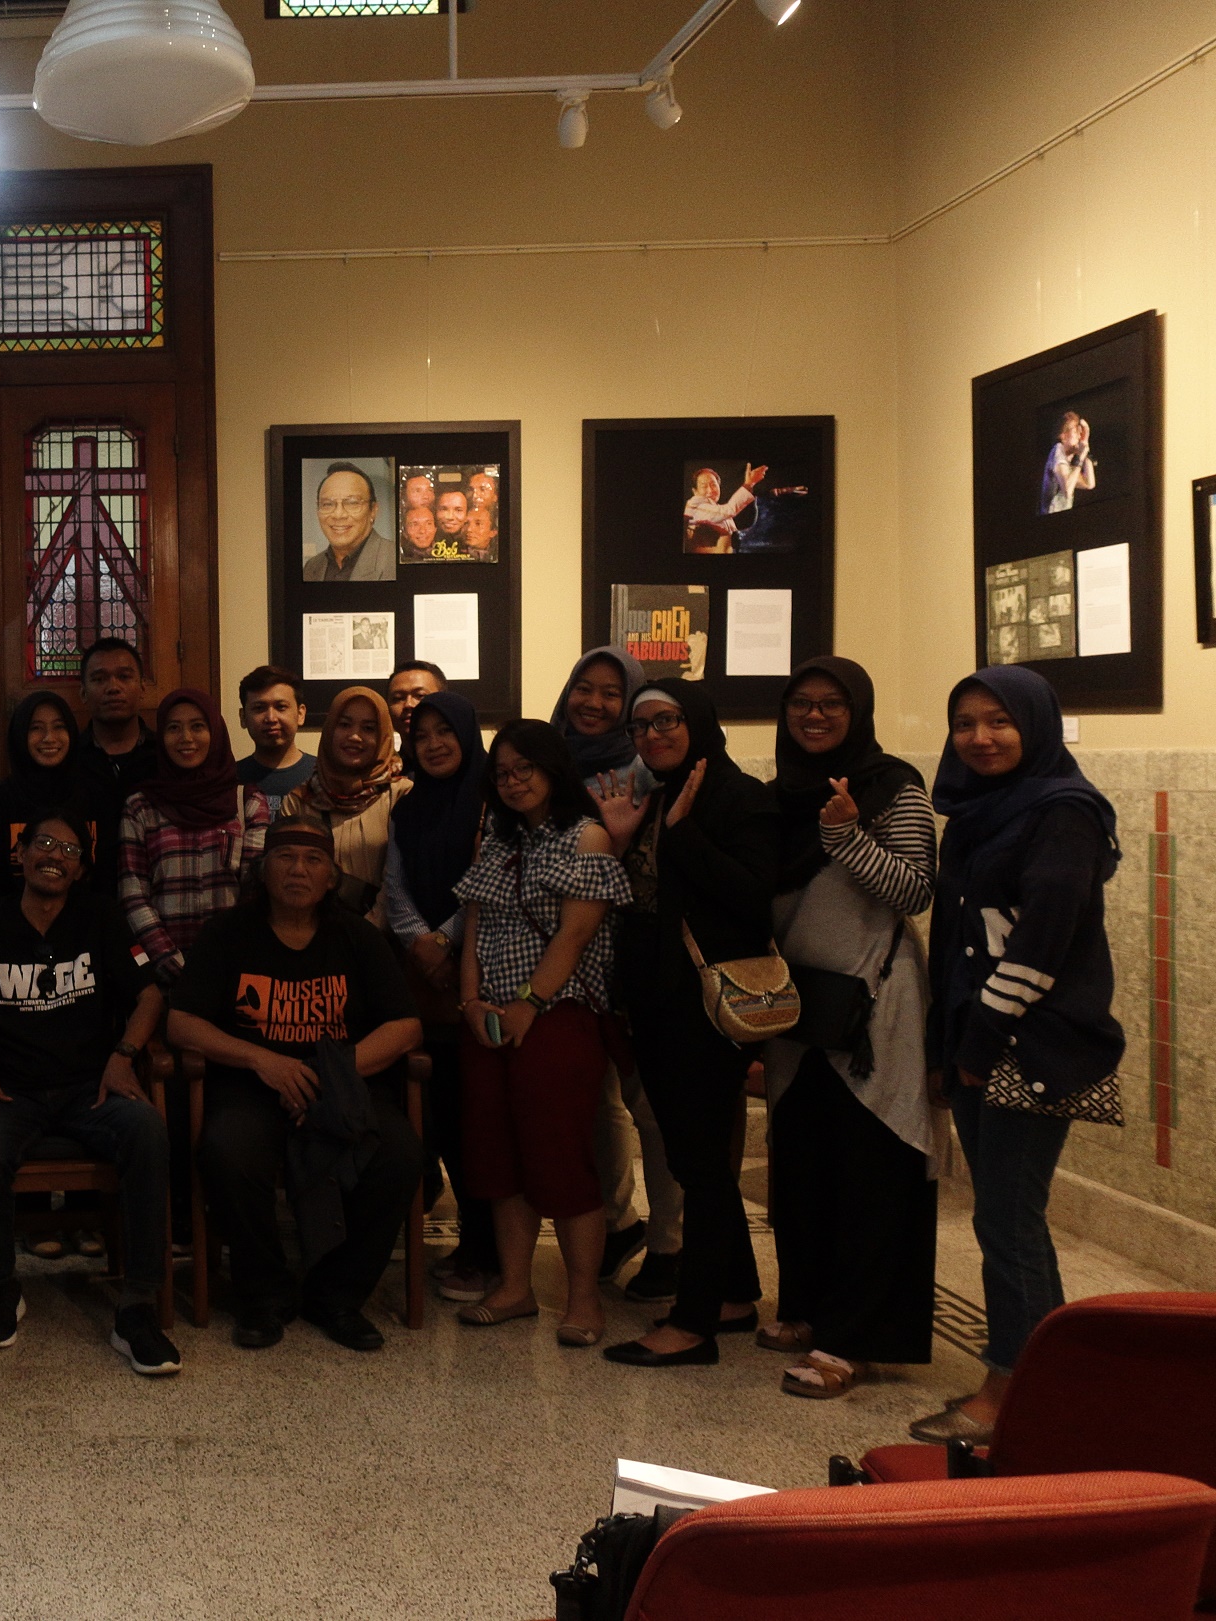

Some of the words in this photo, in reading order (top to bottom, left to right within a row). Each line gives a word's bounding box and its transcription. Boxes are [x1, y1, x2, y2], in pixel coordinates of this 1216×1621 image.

[432, 539, 458, 558] Bob
[652, 606, 690, 642] CHEN
[628, 632, 639, 642] AND
[641, 632, 652, 642] HIS
[627, 641, 689, 661] FABULOUS
[274, 974, 348, 1002] MUSEUM
[272, 995, 348, 1024] MUSIK
[268, 1023, 349, 1043] INDONESIA
